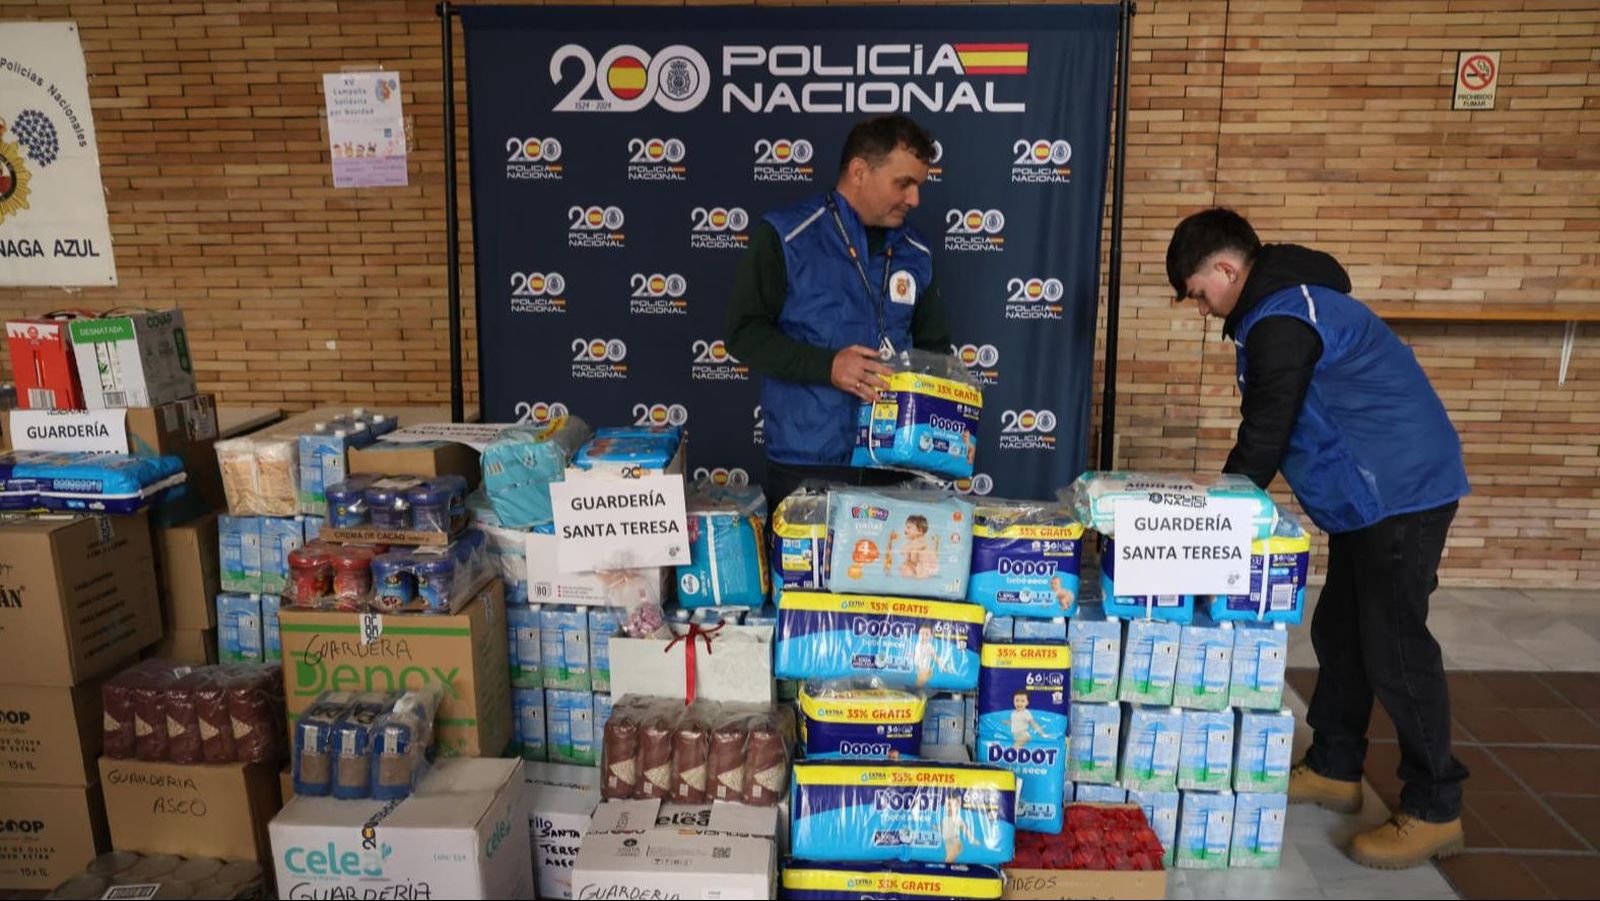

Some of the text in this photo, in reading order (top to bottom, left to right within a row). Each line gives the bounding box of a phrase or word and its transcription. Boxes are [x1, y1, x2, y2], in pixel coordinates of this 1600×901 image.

[549, 43, 711, 113] 200
[722, 81, 1026, 113] NACIONAL
[47, 83, 88, 148] Nacionales
[506, 137, 562, 162] 200
[628, 138, 686, 163] 200
[754, 139, 813, 164] 200
[1013, 139, 1072, 165] 200
[507, 172, 562, 180] NACIONAL
[628, 173, 685, 181] NACIONAL
[754, 174, 812, 182] NACIONAL
[1012, 176, 1070, 184] NACIONAL
[568, 205, 625, 230] 200
[691, 207, 749, 231] 200
[946, 208, 1005, 234] 200
[53, 239, 100, 257] AZUL
[569, 240, 624, 248] NACIONAL
[691, 241, 748, 249] NACIONAL
[945, 244, 1004, 252] NACIONAL
[510, 272, 566, 297] 200
[630, 273, 687, 298] 200
[1007, 277, 1064, 302] 200
[631, 306, 686, 314] NACIONAL
[1006, 312, 1062, 320] NACIONAL
[80, 326, 124, 337] DESNATADA
[571, 338, 627, 362] 200
[692, 372, 748, 380] NACIONAL
[27, 421, 109, 439] GUARDERÍA
[930, 414, 966, 434] DODOT
[1001, 409, 1057, 433] 200
[1000, 442, 1055, 450] NACIONAL
[571, 490, 666, 511] GUARDERÍA
[563, 520, 680, 539] SANTA TERESA
[1134, 514, 1232, 532] GUARDERÍA
[333, 531, 364, 540] CREMA
[376, 532, 406, 541] CACAO
[1040, 527, 1073, 538] GRATIS
[1122, 546, 1242, 560] SANTA TERESA
[998, 557, 1058, 577] DODOT
[892, 603, 929, 615] GRATIS
[853, 616, 915, 639] DODOT
[1020, 648, 1058, 659] GRATIS
[289, 650, 461, 700] Denox
[872, 708, 912, 719] GRATIS
[840, 740, 891, 756] DODOT
[987, 744, 1058, 766] DODOT
[107, 768, 199, 792] GUARDERIA
[916, 772, 956, 783] GRATIS
[540, 828, 580, 839] SANTA
[901, 880, 942, 892] GRATIS
